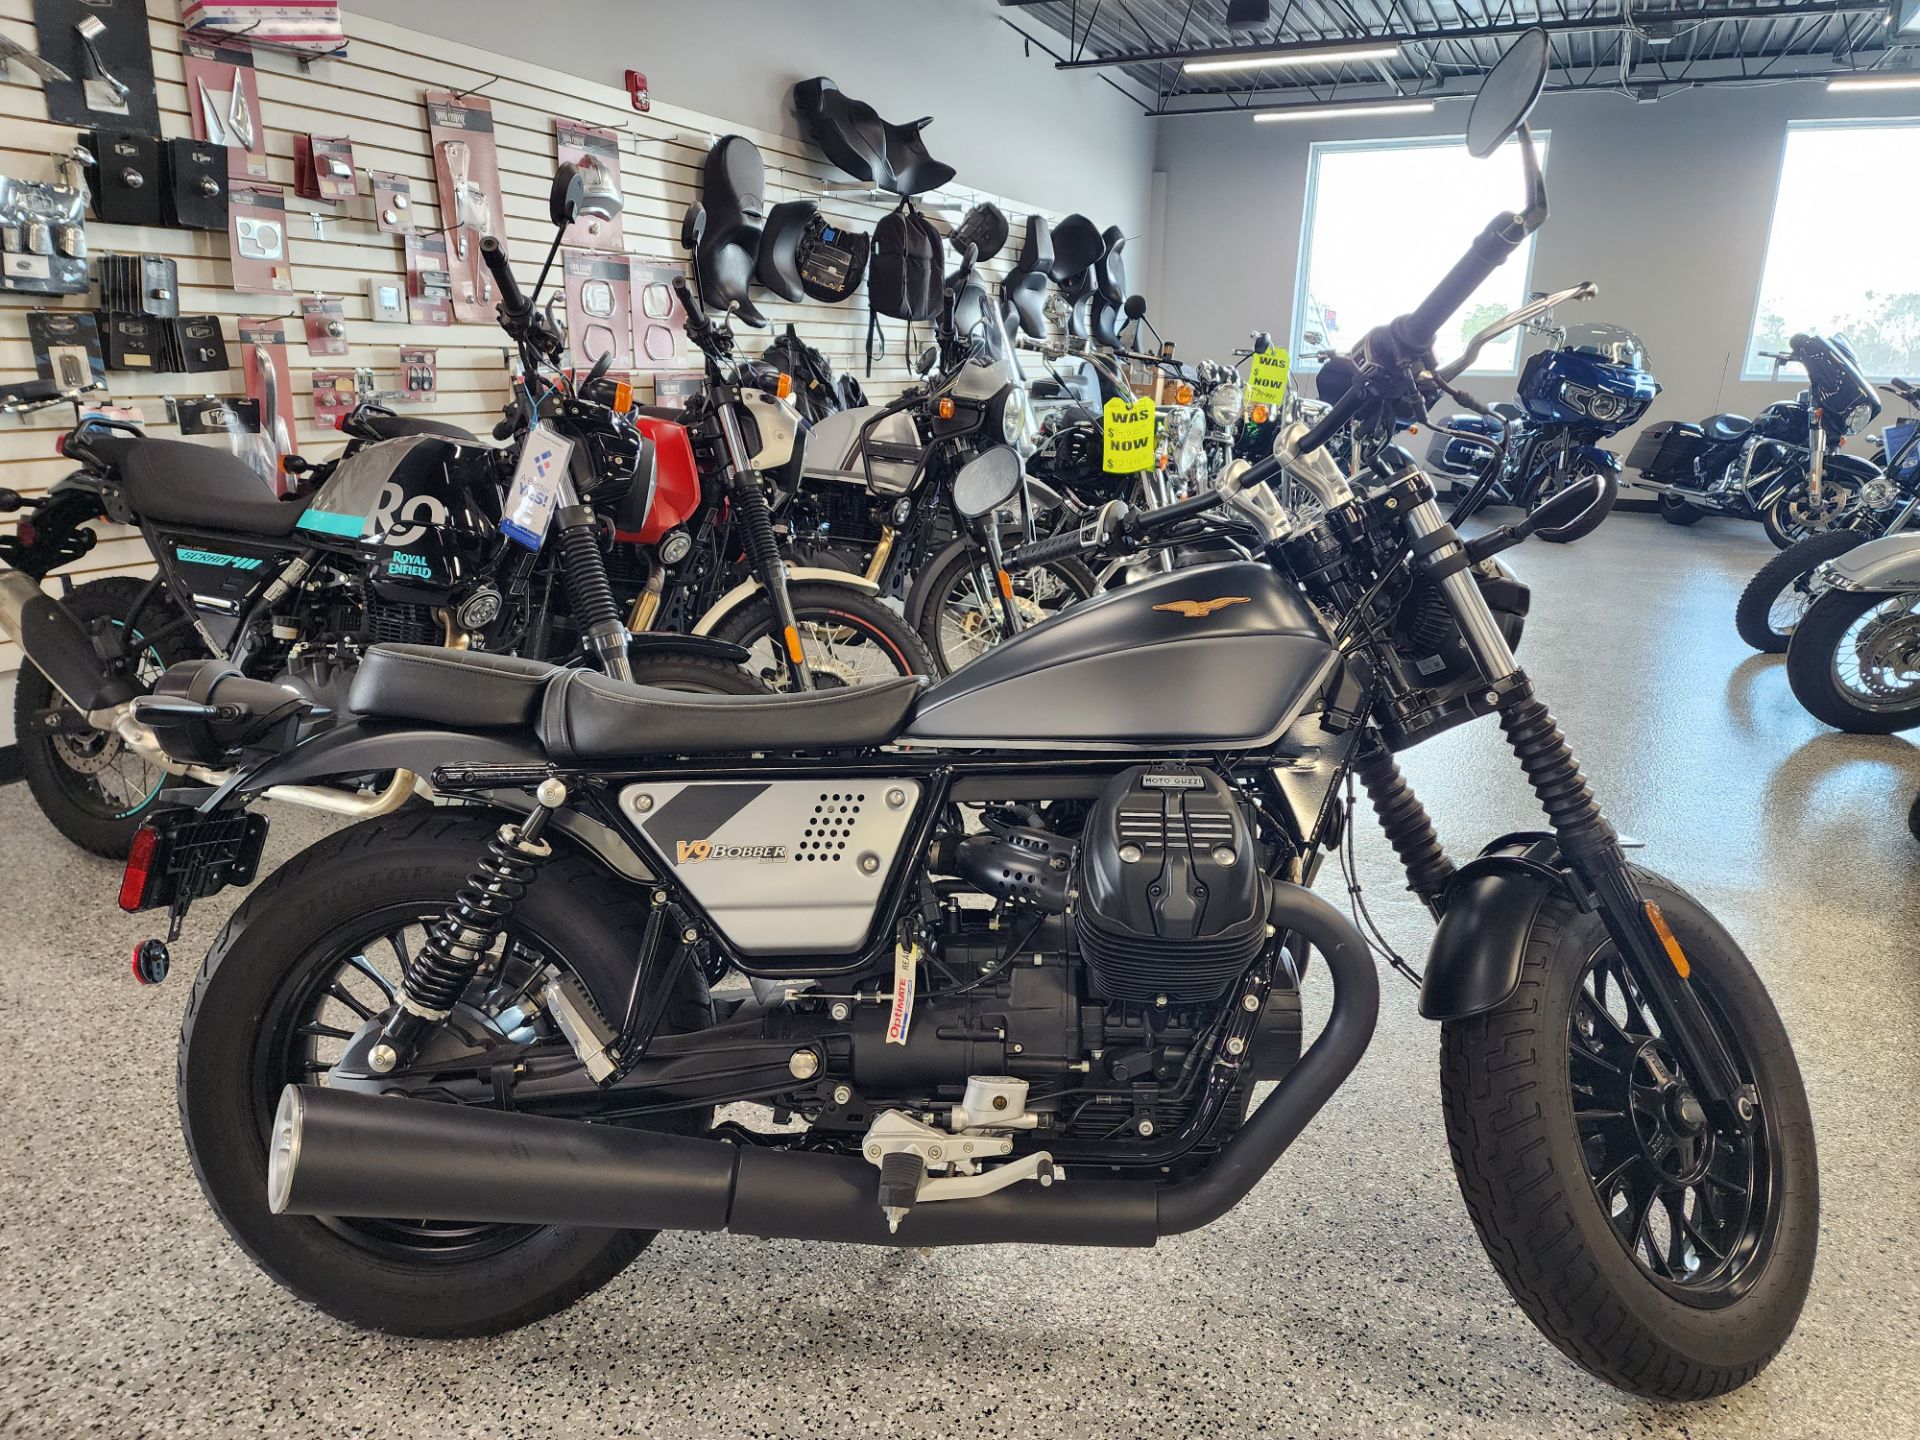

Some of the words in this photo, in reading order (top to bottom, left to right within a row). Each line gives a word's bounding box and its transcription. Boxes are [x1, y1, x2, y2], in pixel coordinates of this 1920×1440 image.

[1260, 357, 1286, 368] WAS
[1254, 378, 1282, 389] NOW
[1112, 410, 1148, 423] WAS
[1110, 437, 1148, 451] NOW
[181, 551, 228, 564] SCRAM
[393, 551, 428, 566] ROYAL
[388, 562, 432, 579] ENFIELD
[677, 840, 712, 864] V9
[711, 845, 786, 858] BOBBER
